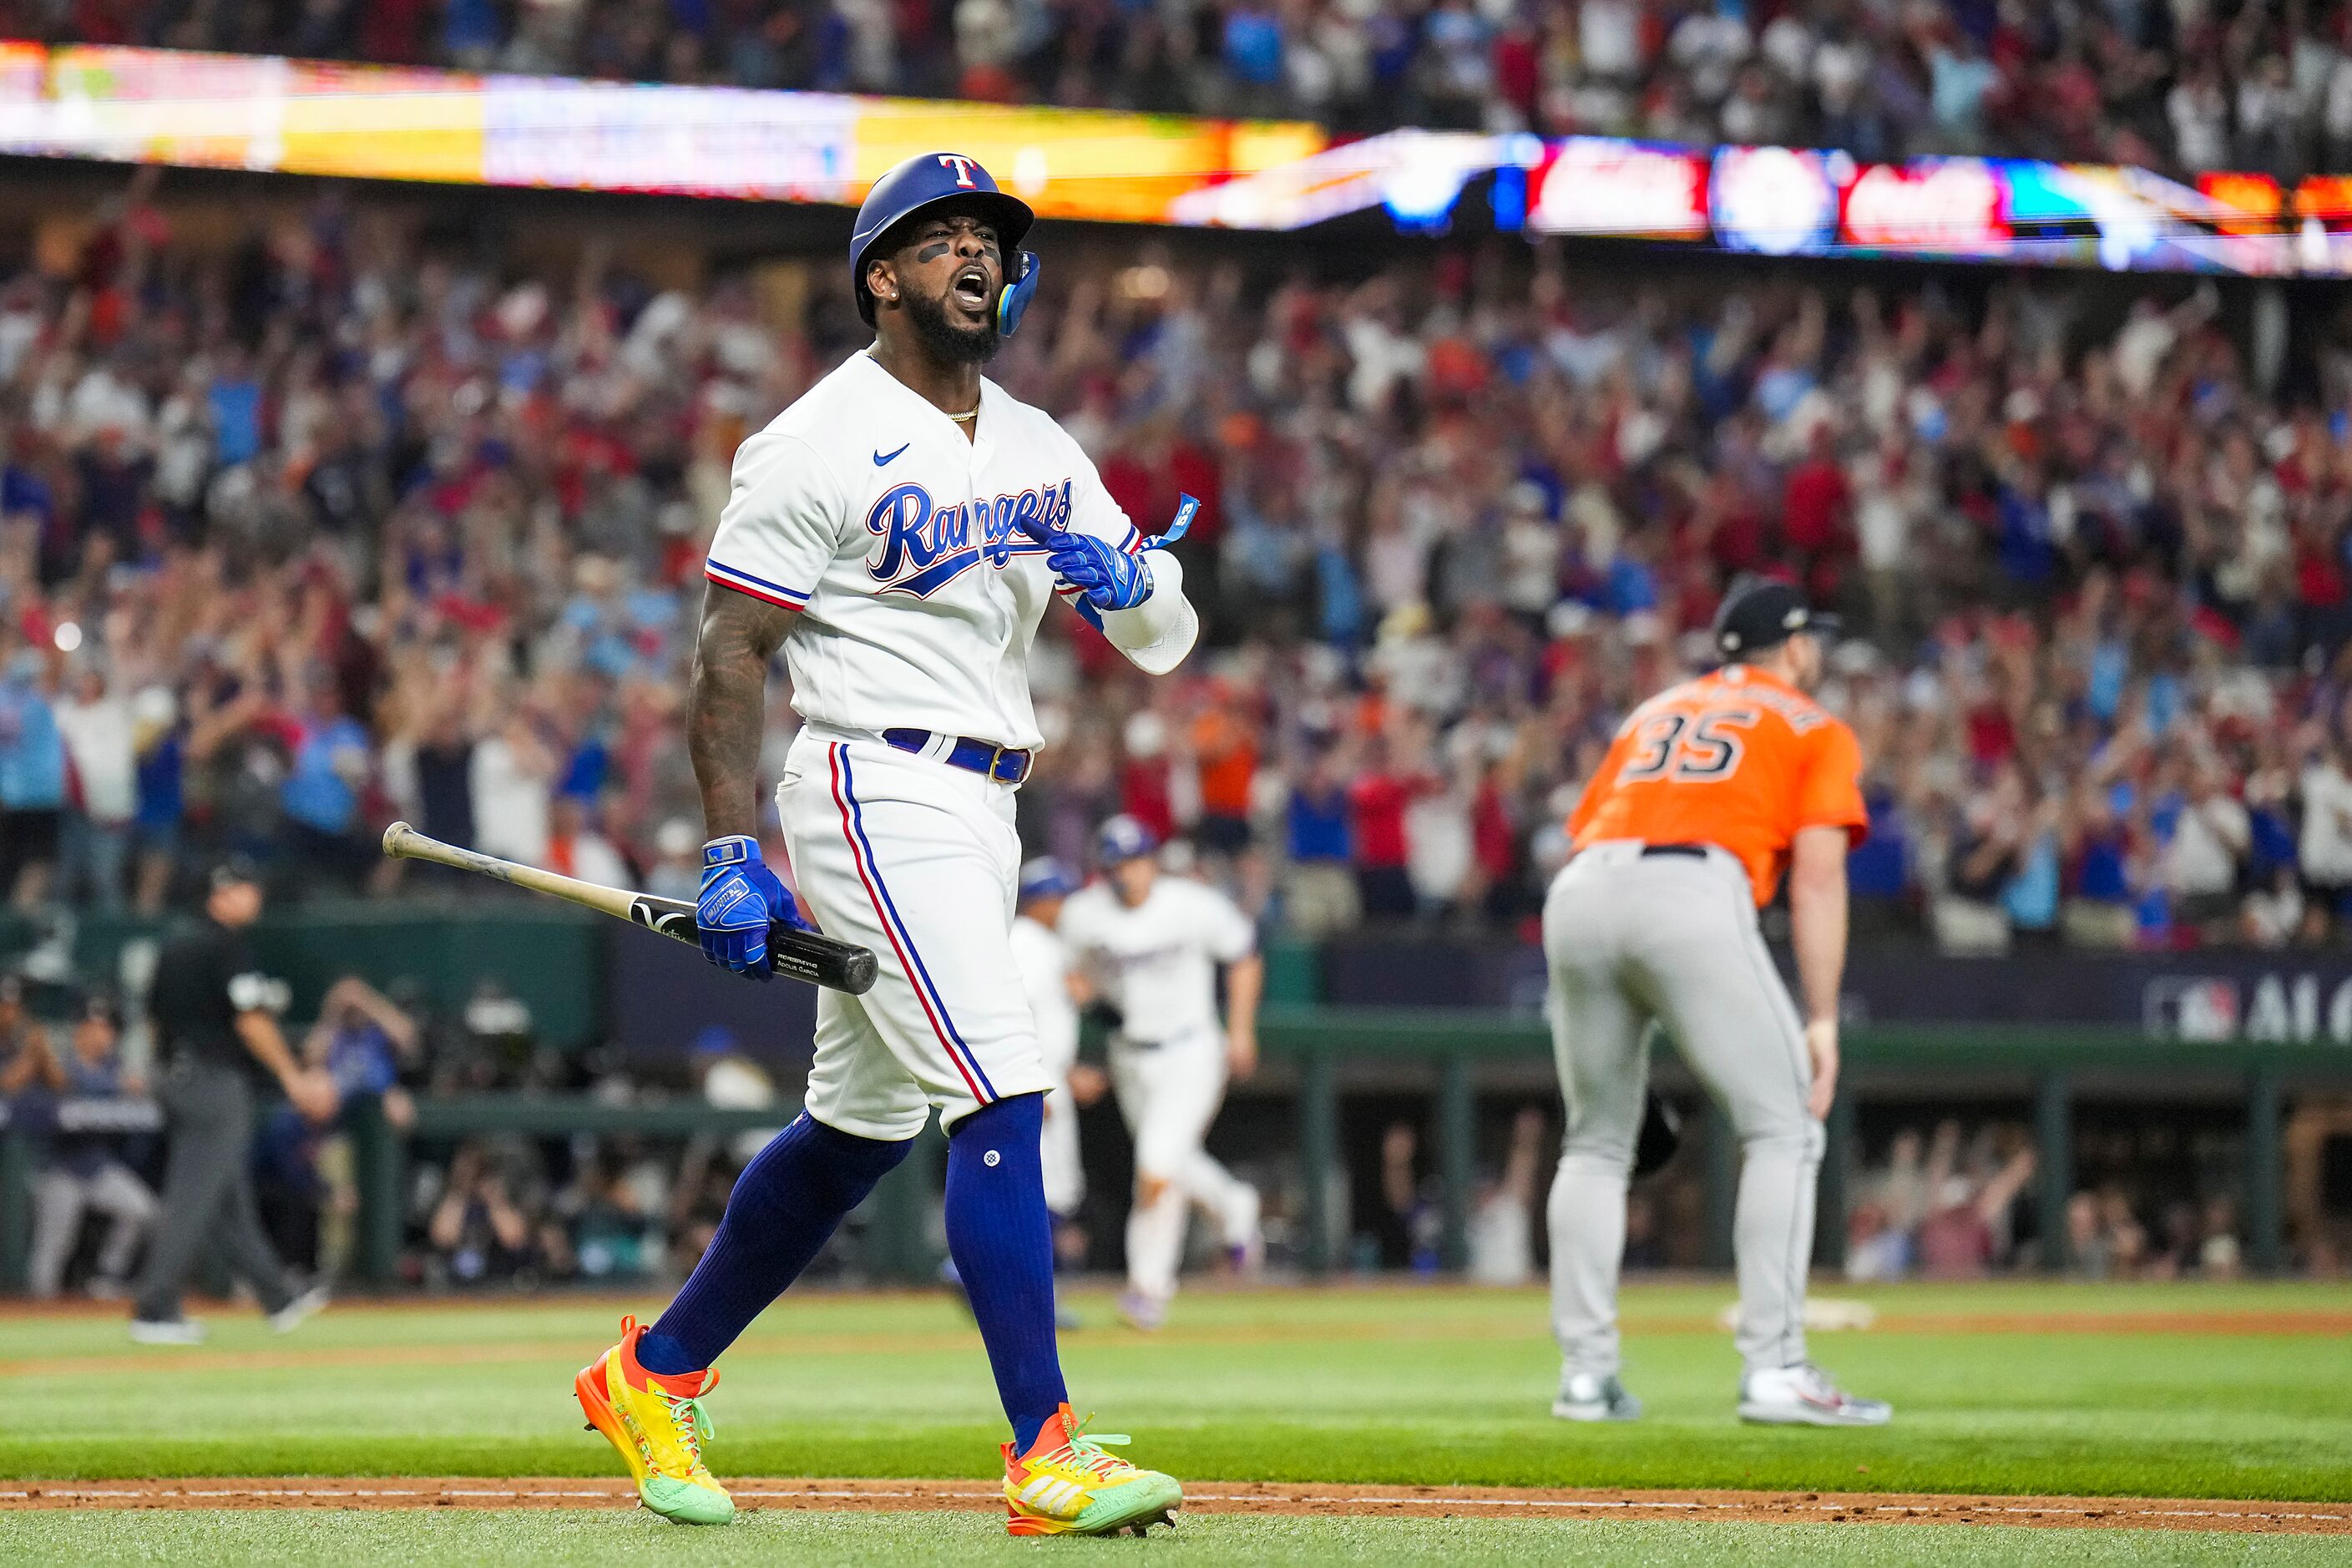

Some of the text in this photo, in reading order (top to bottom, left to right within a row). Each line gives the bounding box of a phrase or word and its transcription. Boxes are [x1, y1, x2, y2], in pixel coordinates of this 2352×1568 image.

[938, 154, 977, 190] T
[865, 478, 1073, 583] Rangers
[1175, 502, 1195, 527] 53
[1614, 709, 1763, 786] 35
